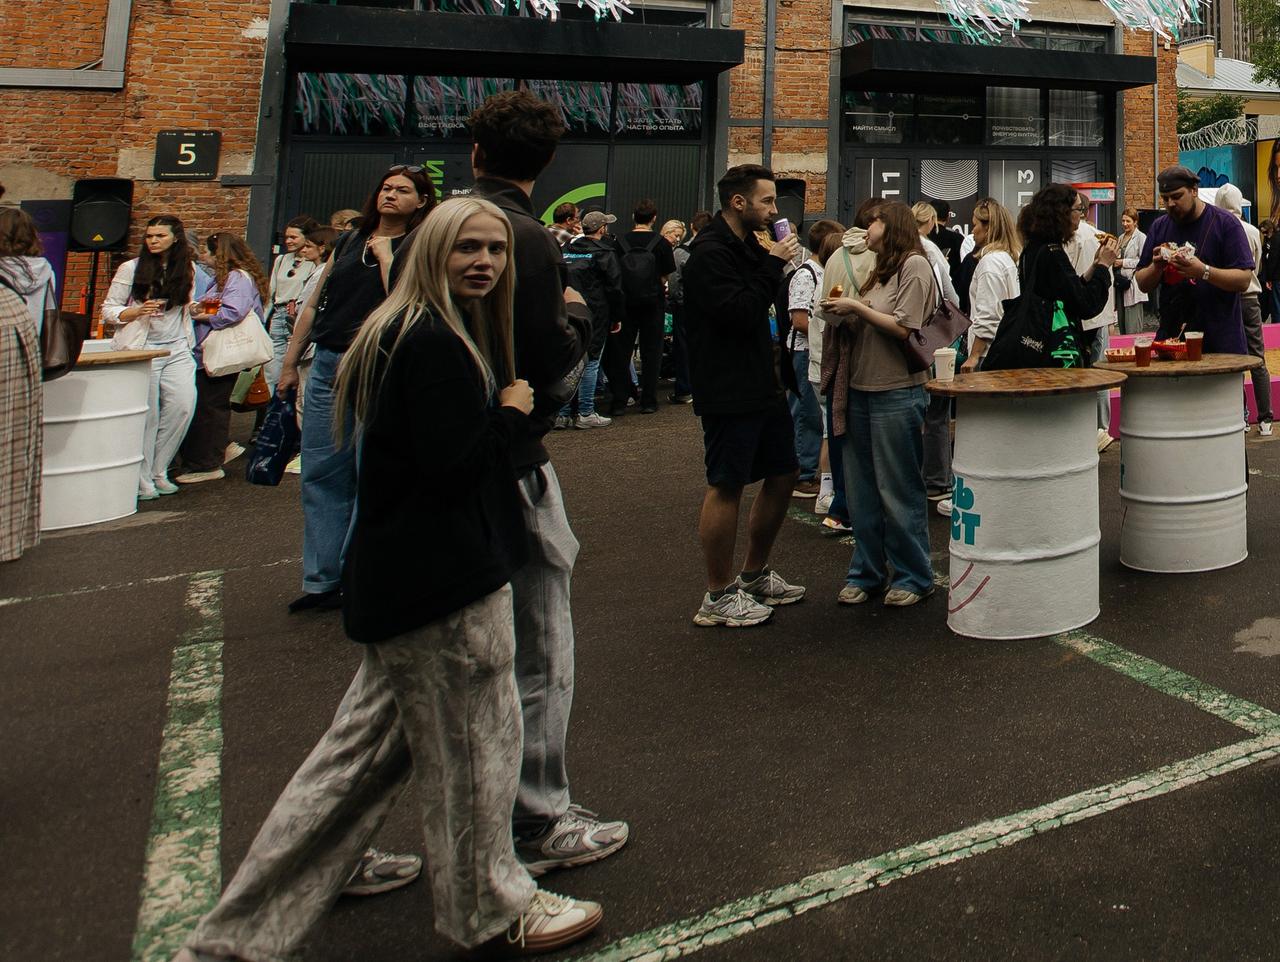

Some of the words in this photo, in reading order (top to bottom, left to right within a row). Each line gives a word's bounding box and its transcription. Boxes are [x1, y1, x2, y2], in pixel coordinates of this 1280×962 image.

[178, 143, 197, 165] 5
[882, 172, 900, 182] 1
[1018, 169, 1034, 184] 3
